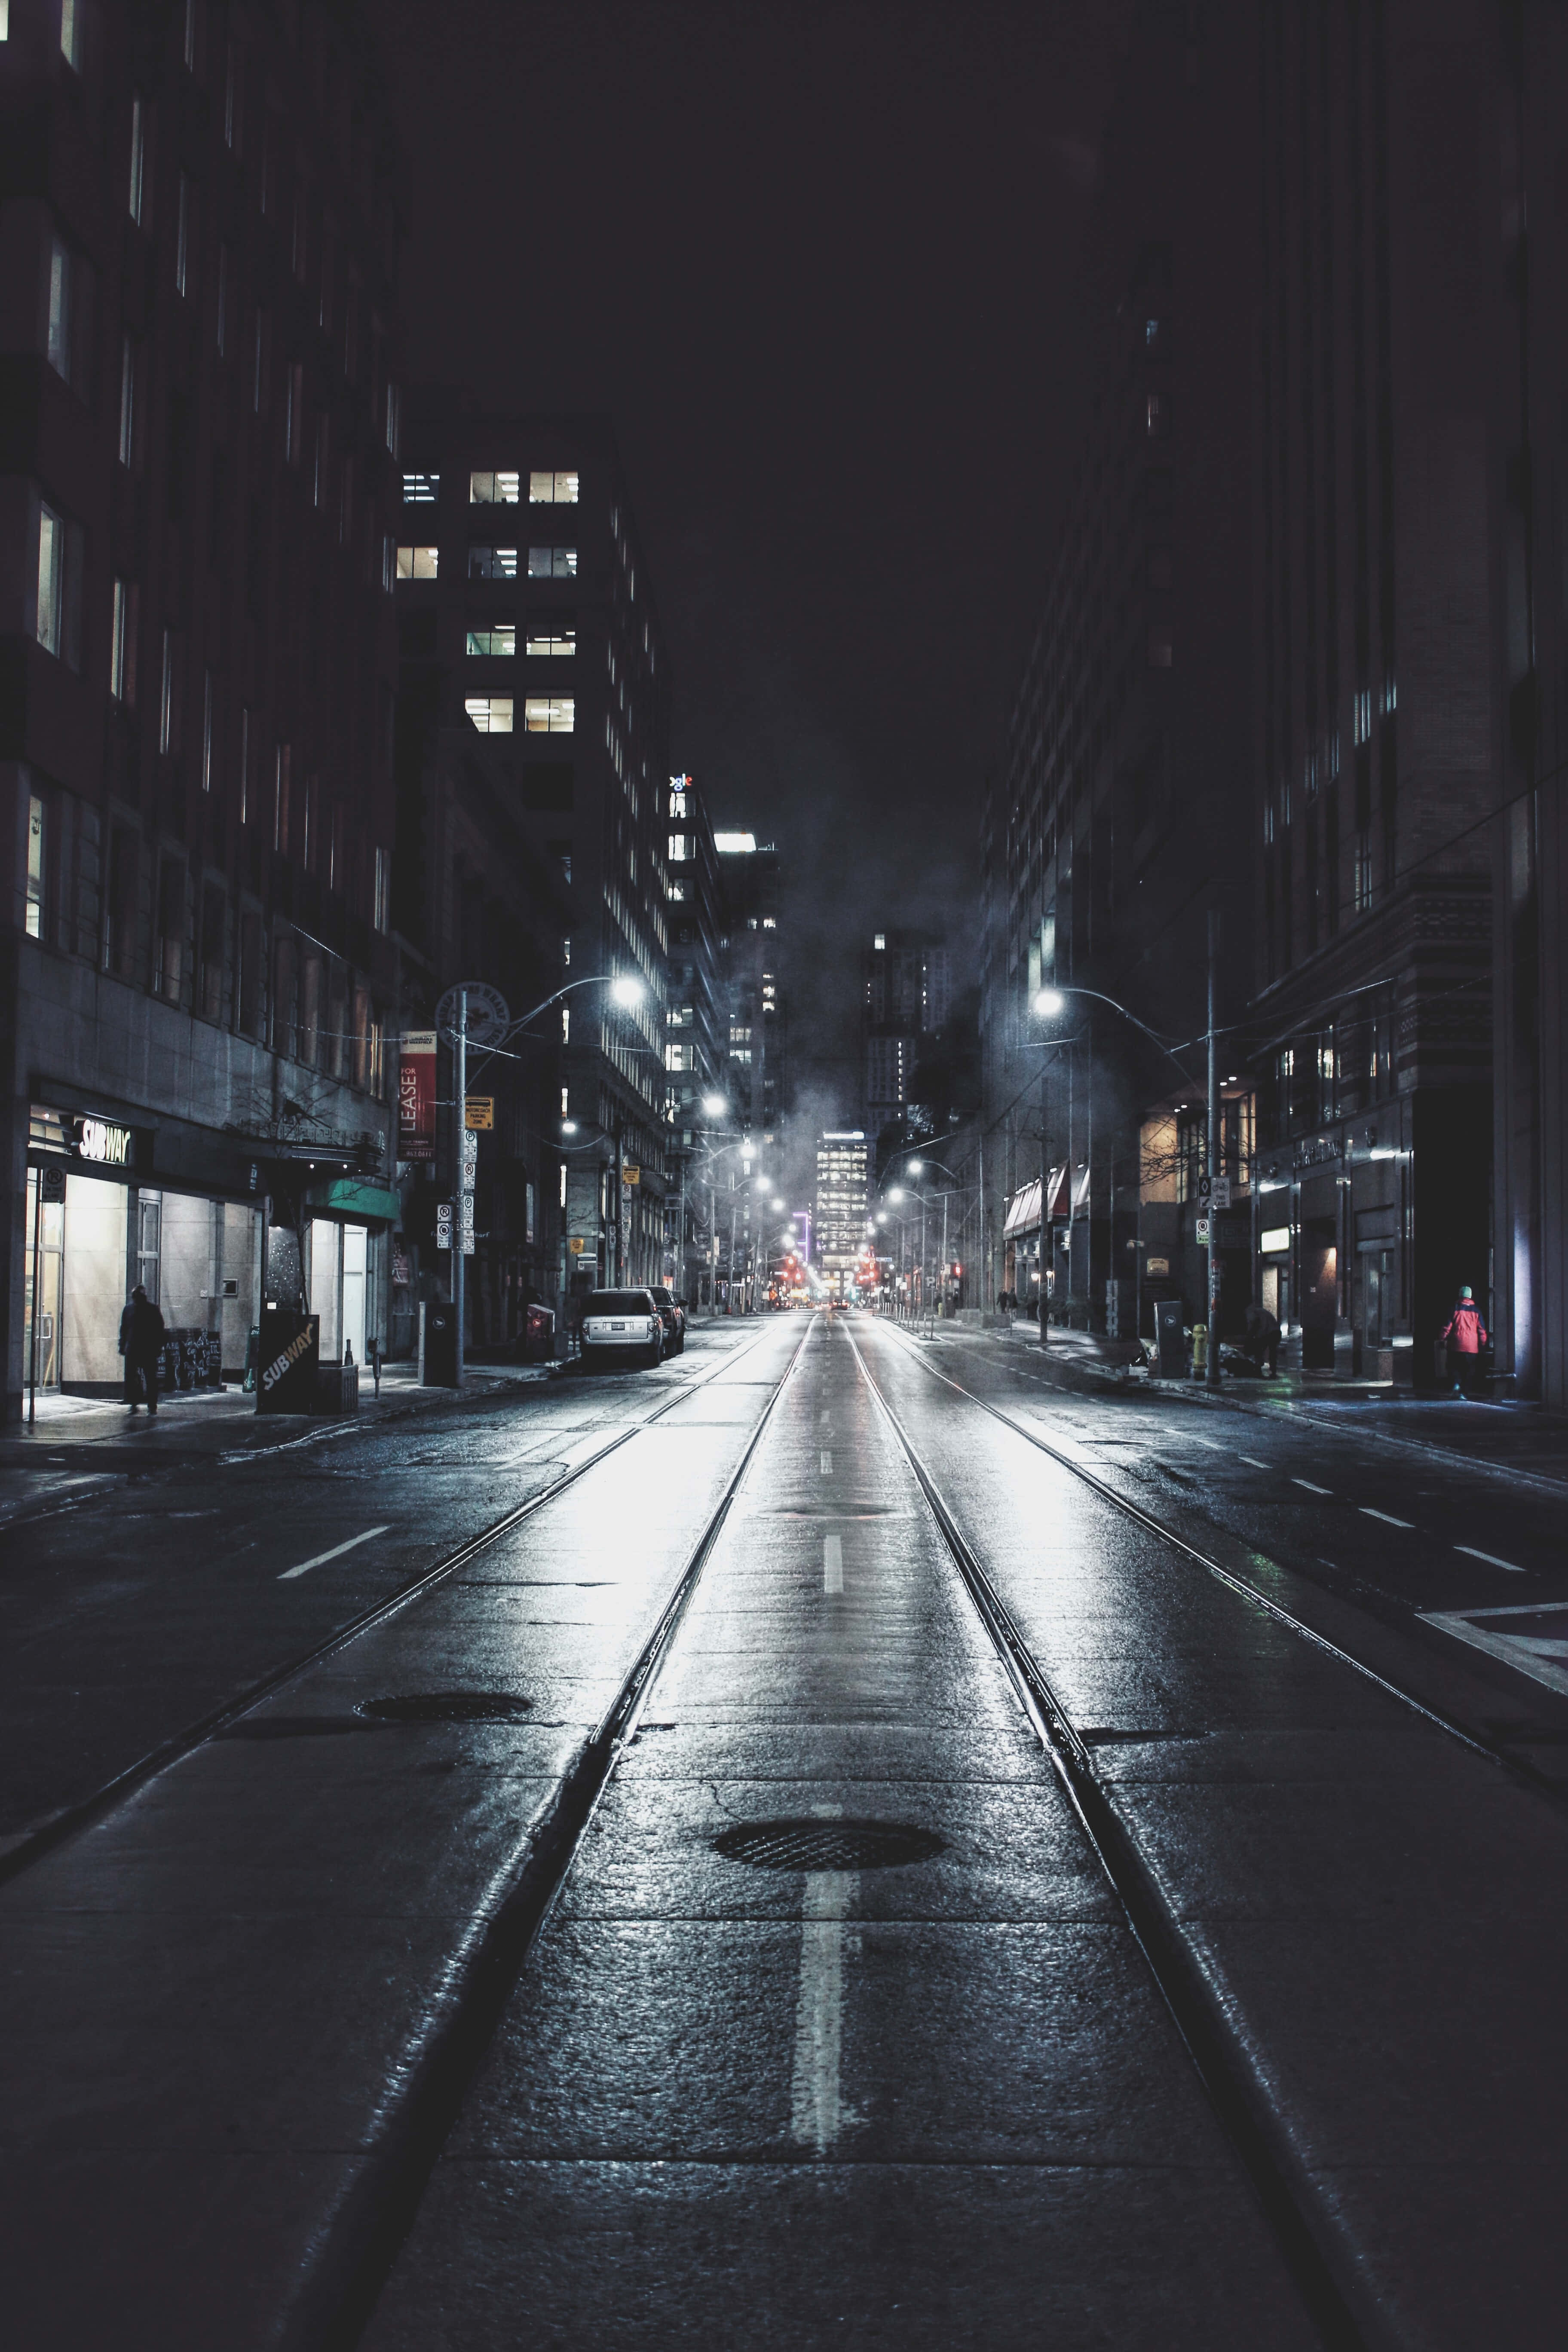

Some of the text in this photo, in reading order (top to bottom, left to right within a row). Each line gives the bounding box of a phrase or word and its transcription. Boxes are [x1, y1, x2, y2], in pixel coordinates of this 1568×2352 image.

[669, 774, 693, 792] ogle
[401, 1076, 416, 1131] LEASE
[79, 1119, 131, 1163] SUBWAY
[262, 1323, 314, 1390] SUBWAY
